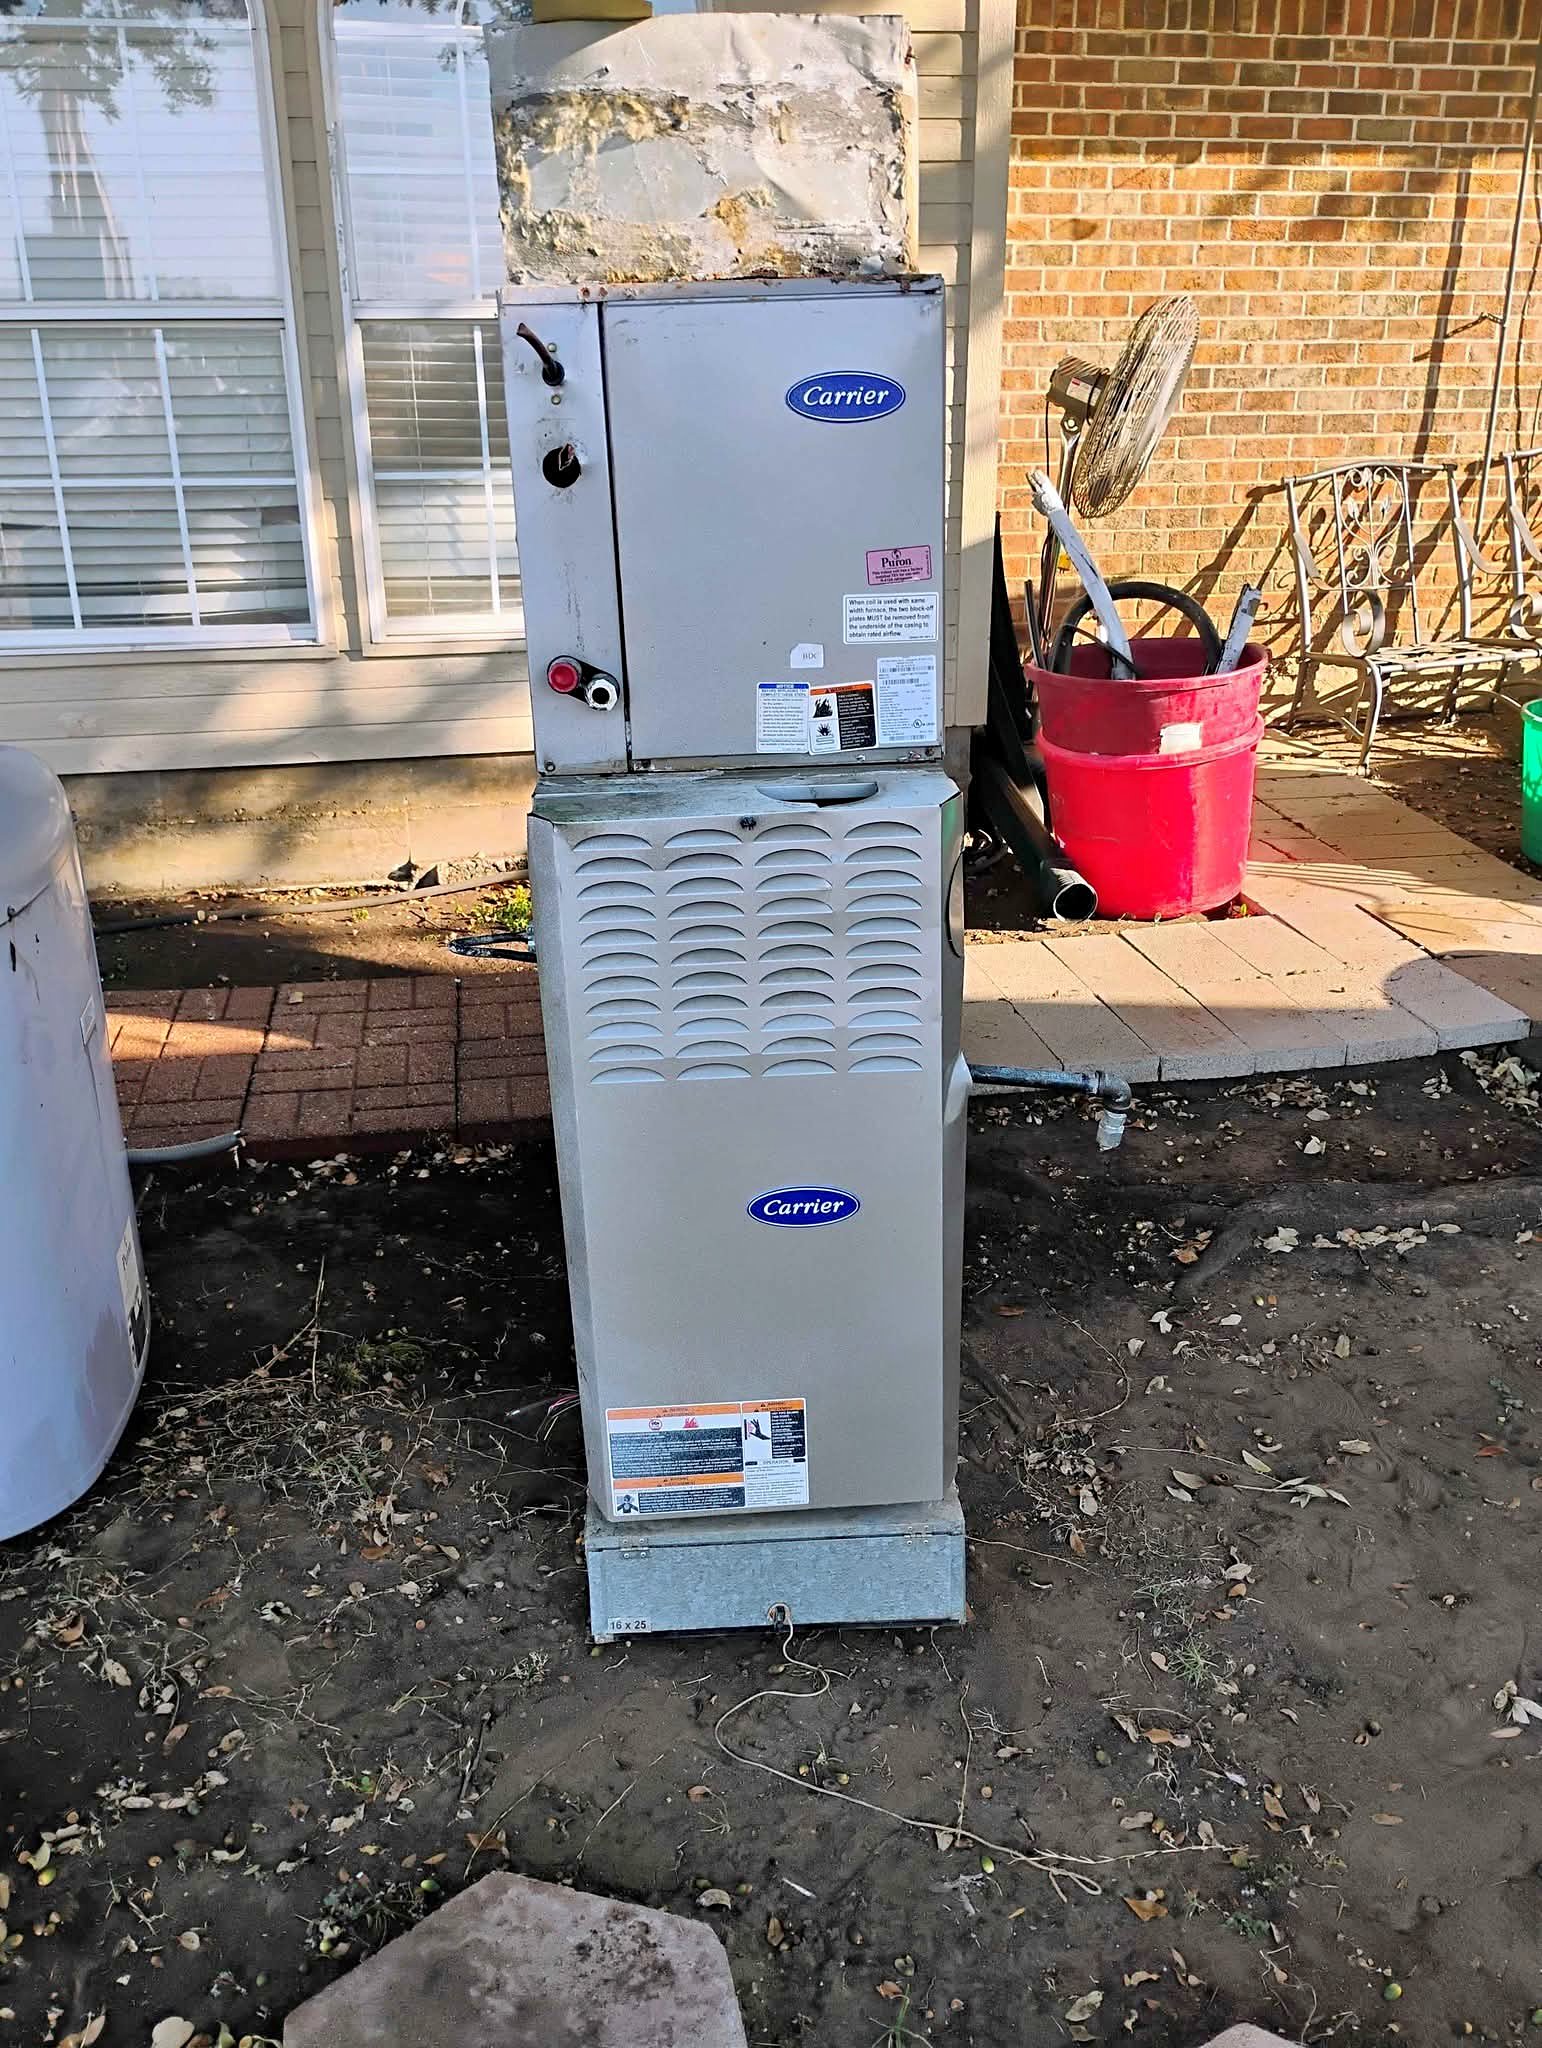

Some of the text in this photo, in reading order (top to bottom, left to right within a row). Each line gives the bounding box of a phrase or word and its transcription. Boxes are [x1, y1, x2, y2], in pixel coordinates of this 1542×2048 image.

[803, 386, 889, 406] Carrier
[881, 557, 912, 568] Puron
[763, 1198, 845, 1216] Carrier
[611, 1620, 646, 1630] 16 x 25
